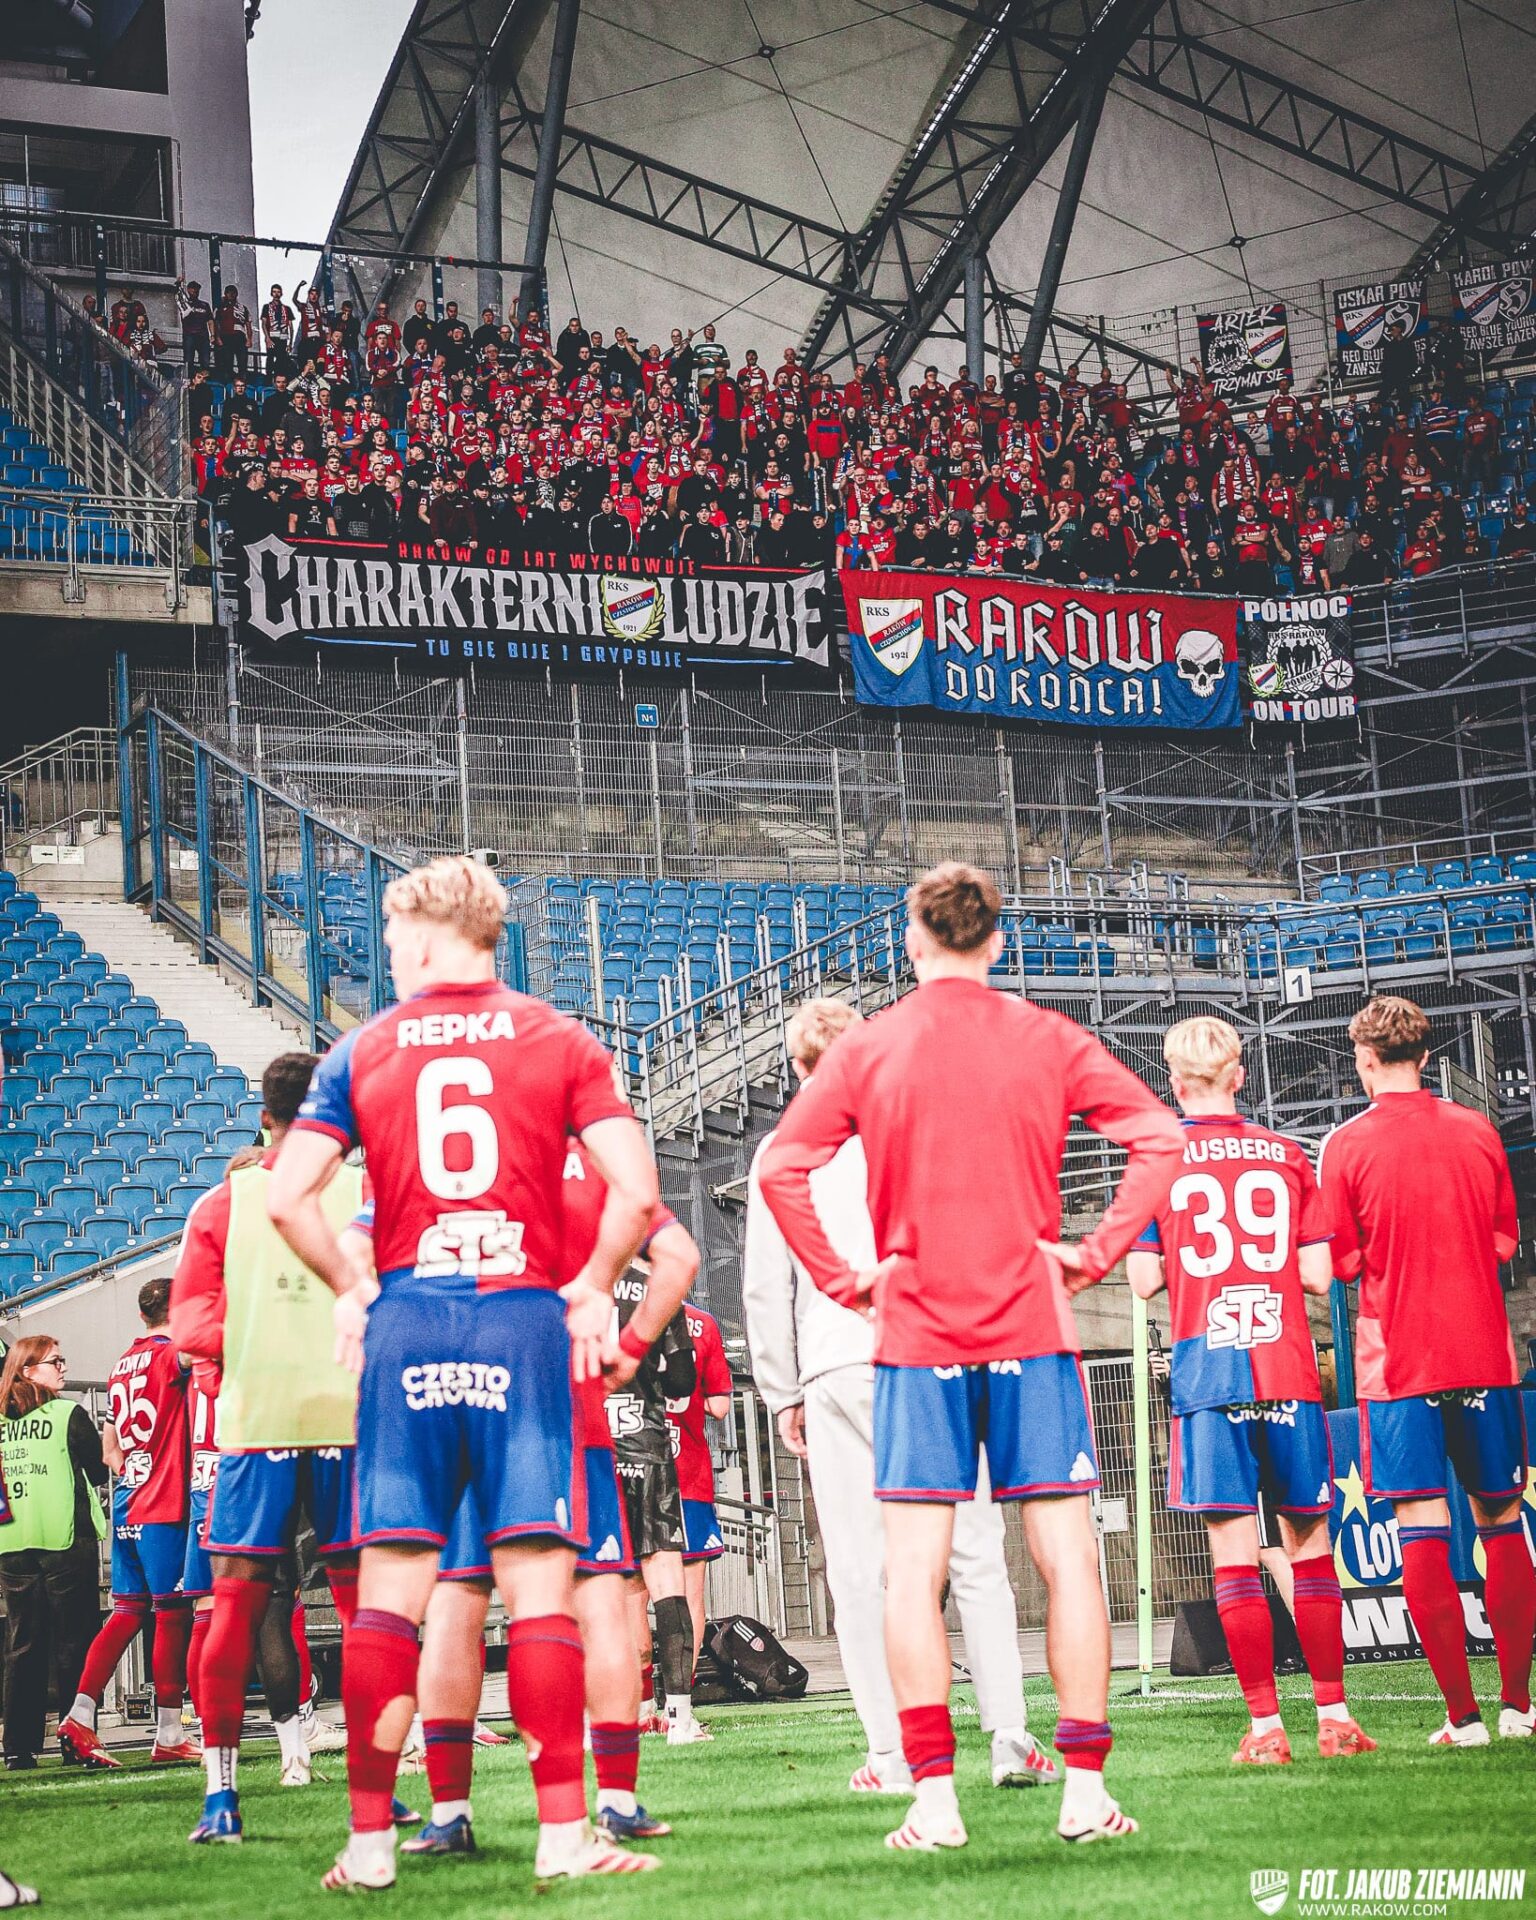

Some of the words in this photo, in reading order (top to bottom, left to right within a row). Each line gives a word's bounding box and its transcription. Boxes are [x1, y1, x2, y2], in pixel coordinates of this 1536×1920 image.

[1338, 285, 1384, 309] OSKAR
[1209, 304, 1276, 334] ARTEK
[1345, 311, 1363, 321] RKS
[1504, 313, 1536, 332] YOUNG
[1248, 331, 1265, 339] RKS
[1464, 336, 1504, 350] ZAWSZE
[1342, 350, 1360, 362] RED
[1345, 362, 1382, 376] ZAWSZ
[486, 548, 511, 566] OD
[523, 550, 557, 568] LAT
[570, 553, 695, 576] WYCHOWUJE
[607, 580, 629, 592] RKS
[243, 533, 606, 641] CHARAKTERNI
[657, 570, 829, 667] LUDZIE
[866, 606, 890, 617] RKS
[1244, 596, 1348, 622] PÓŁNOC
[623, 624, 637, 632] 1921
[934, 587, 1164, 674] RAKÓW
[425, 639, 450, 656] TU
[508, 641, 549, 660] BIJE
[562, 645, 568, 661] I
[581, 645, 682, 668] GRYPSUJE
[890, 651, 909, 660] 1921
[944, 659, 996, 703] DO
[1009, 667, 1164, 716] KOŃCA!
[641, 713, 654, 722] N1
[1253, 700, 1285, 722] ON
[1288, 695, 1355, 722] TOUR
[1291, 974, 1304, 997] 1
[397, 1011, 516, 1048] REPKA
[415, 1055, 499, 1200] 6
[1169, 1169, 1290, 1278] 39
[412, 1209, 527, 1279] STS
[1206, 1284, 1284, 1350] STS
[110, 1375, 157, 1450] 25
[603, 1392, 645, 1438] TS
[1351, 1517, 1403, 1579] LOT
[1346, 1648, 1422, 1662] OTONIC
[1466, 1644, 1498, 1654] INK
